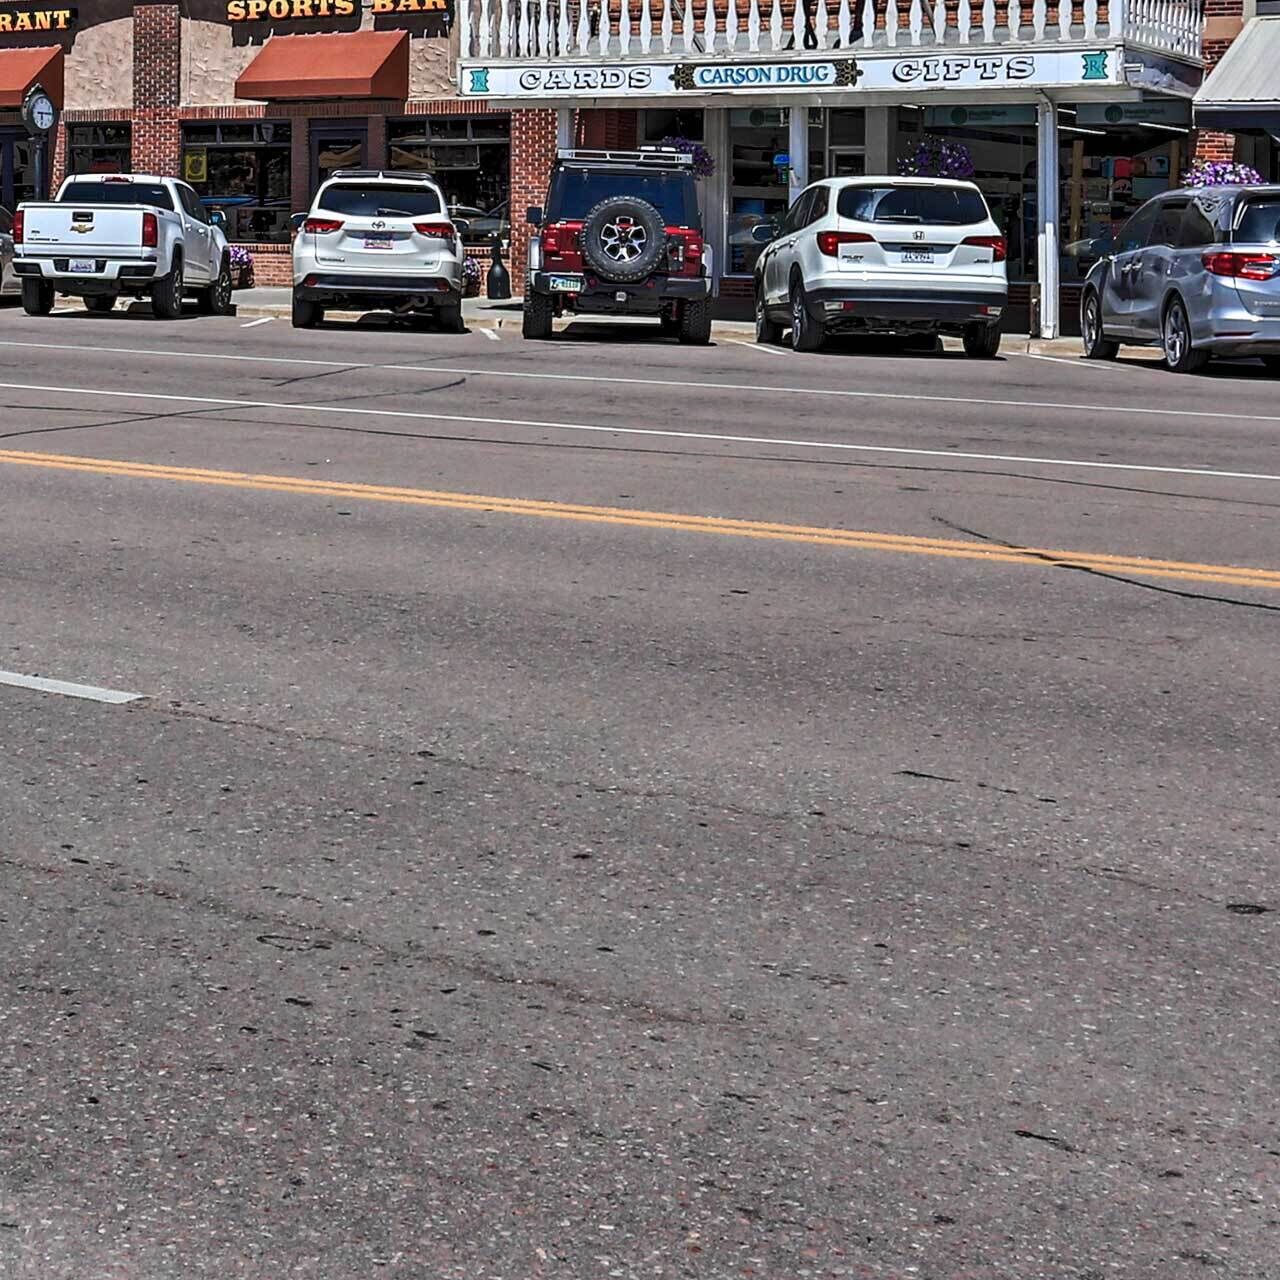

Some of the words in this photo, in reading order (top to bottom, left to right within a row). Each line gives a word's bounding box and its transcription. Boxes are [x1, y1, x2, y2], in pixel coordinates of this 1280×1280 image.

[519, 67, 652, 90] CARDS
[700, 67, 771, 85] CARSON
[776, 65, 829, 84] DRUG
[892, 56, 1036, 83] GIFTS
